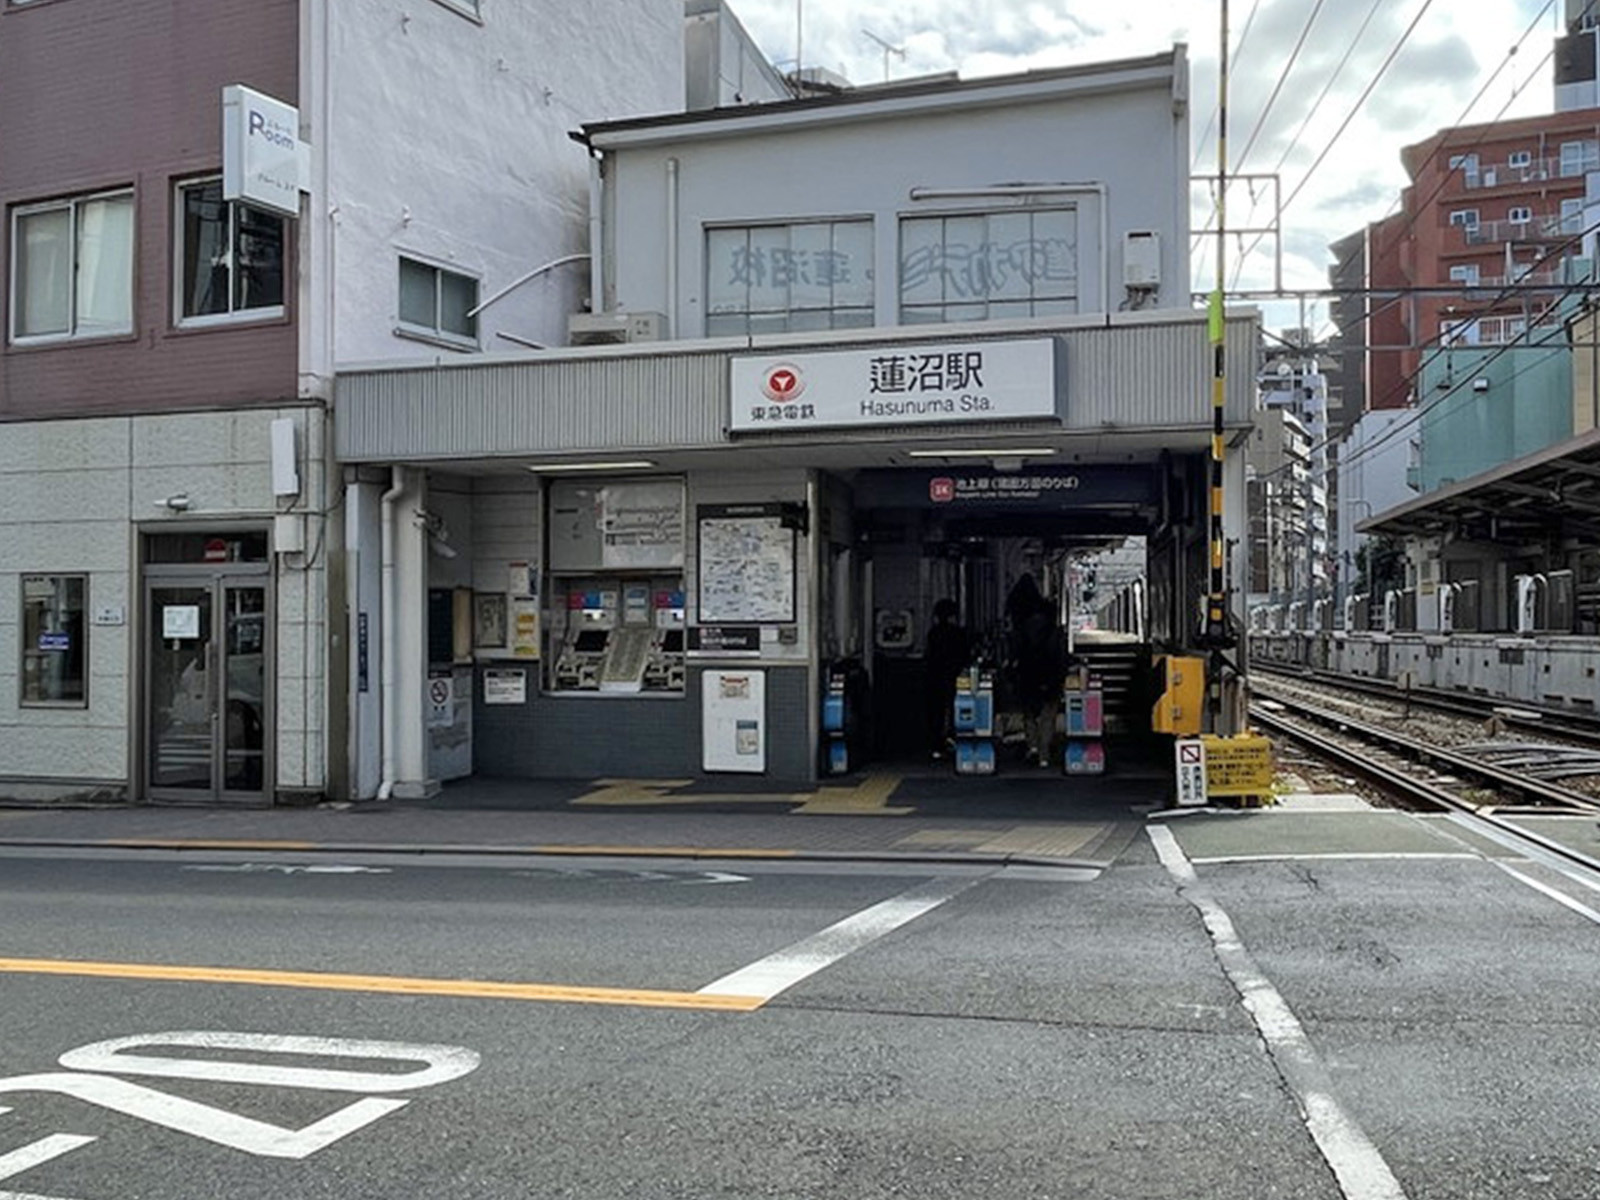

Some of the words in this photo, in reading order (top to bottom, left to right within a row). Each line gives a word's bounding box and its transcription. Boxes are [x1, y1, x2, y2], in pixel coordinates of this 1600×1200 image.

[249, 111, 294, 151] Room
[869, 350, 983, 394] 蓮沼駅
[750, 404, 817, 421] 東急電鉄
[860, 398, 954, 417] Hasunuma
[959, 394, 995, 412] Sta.
